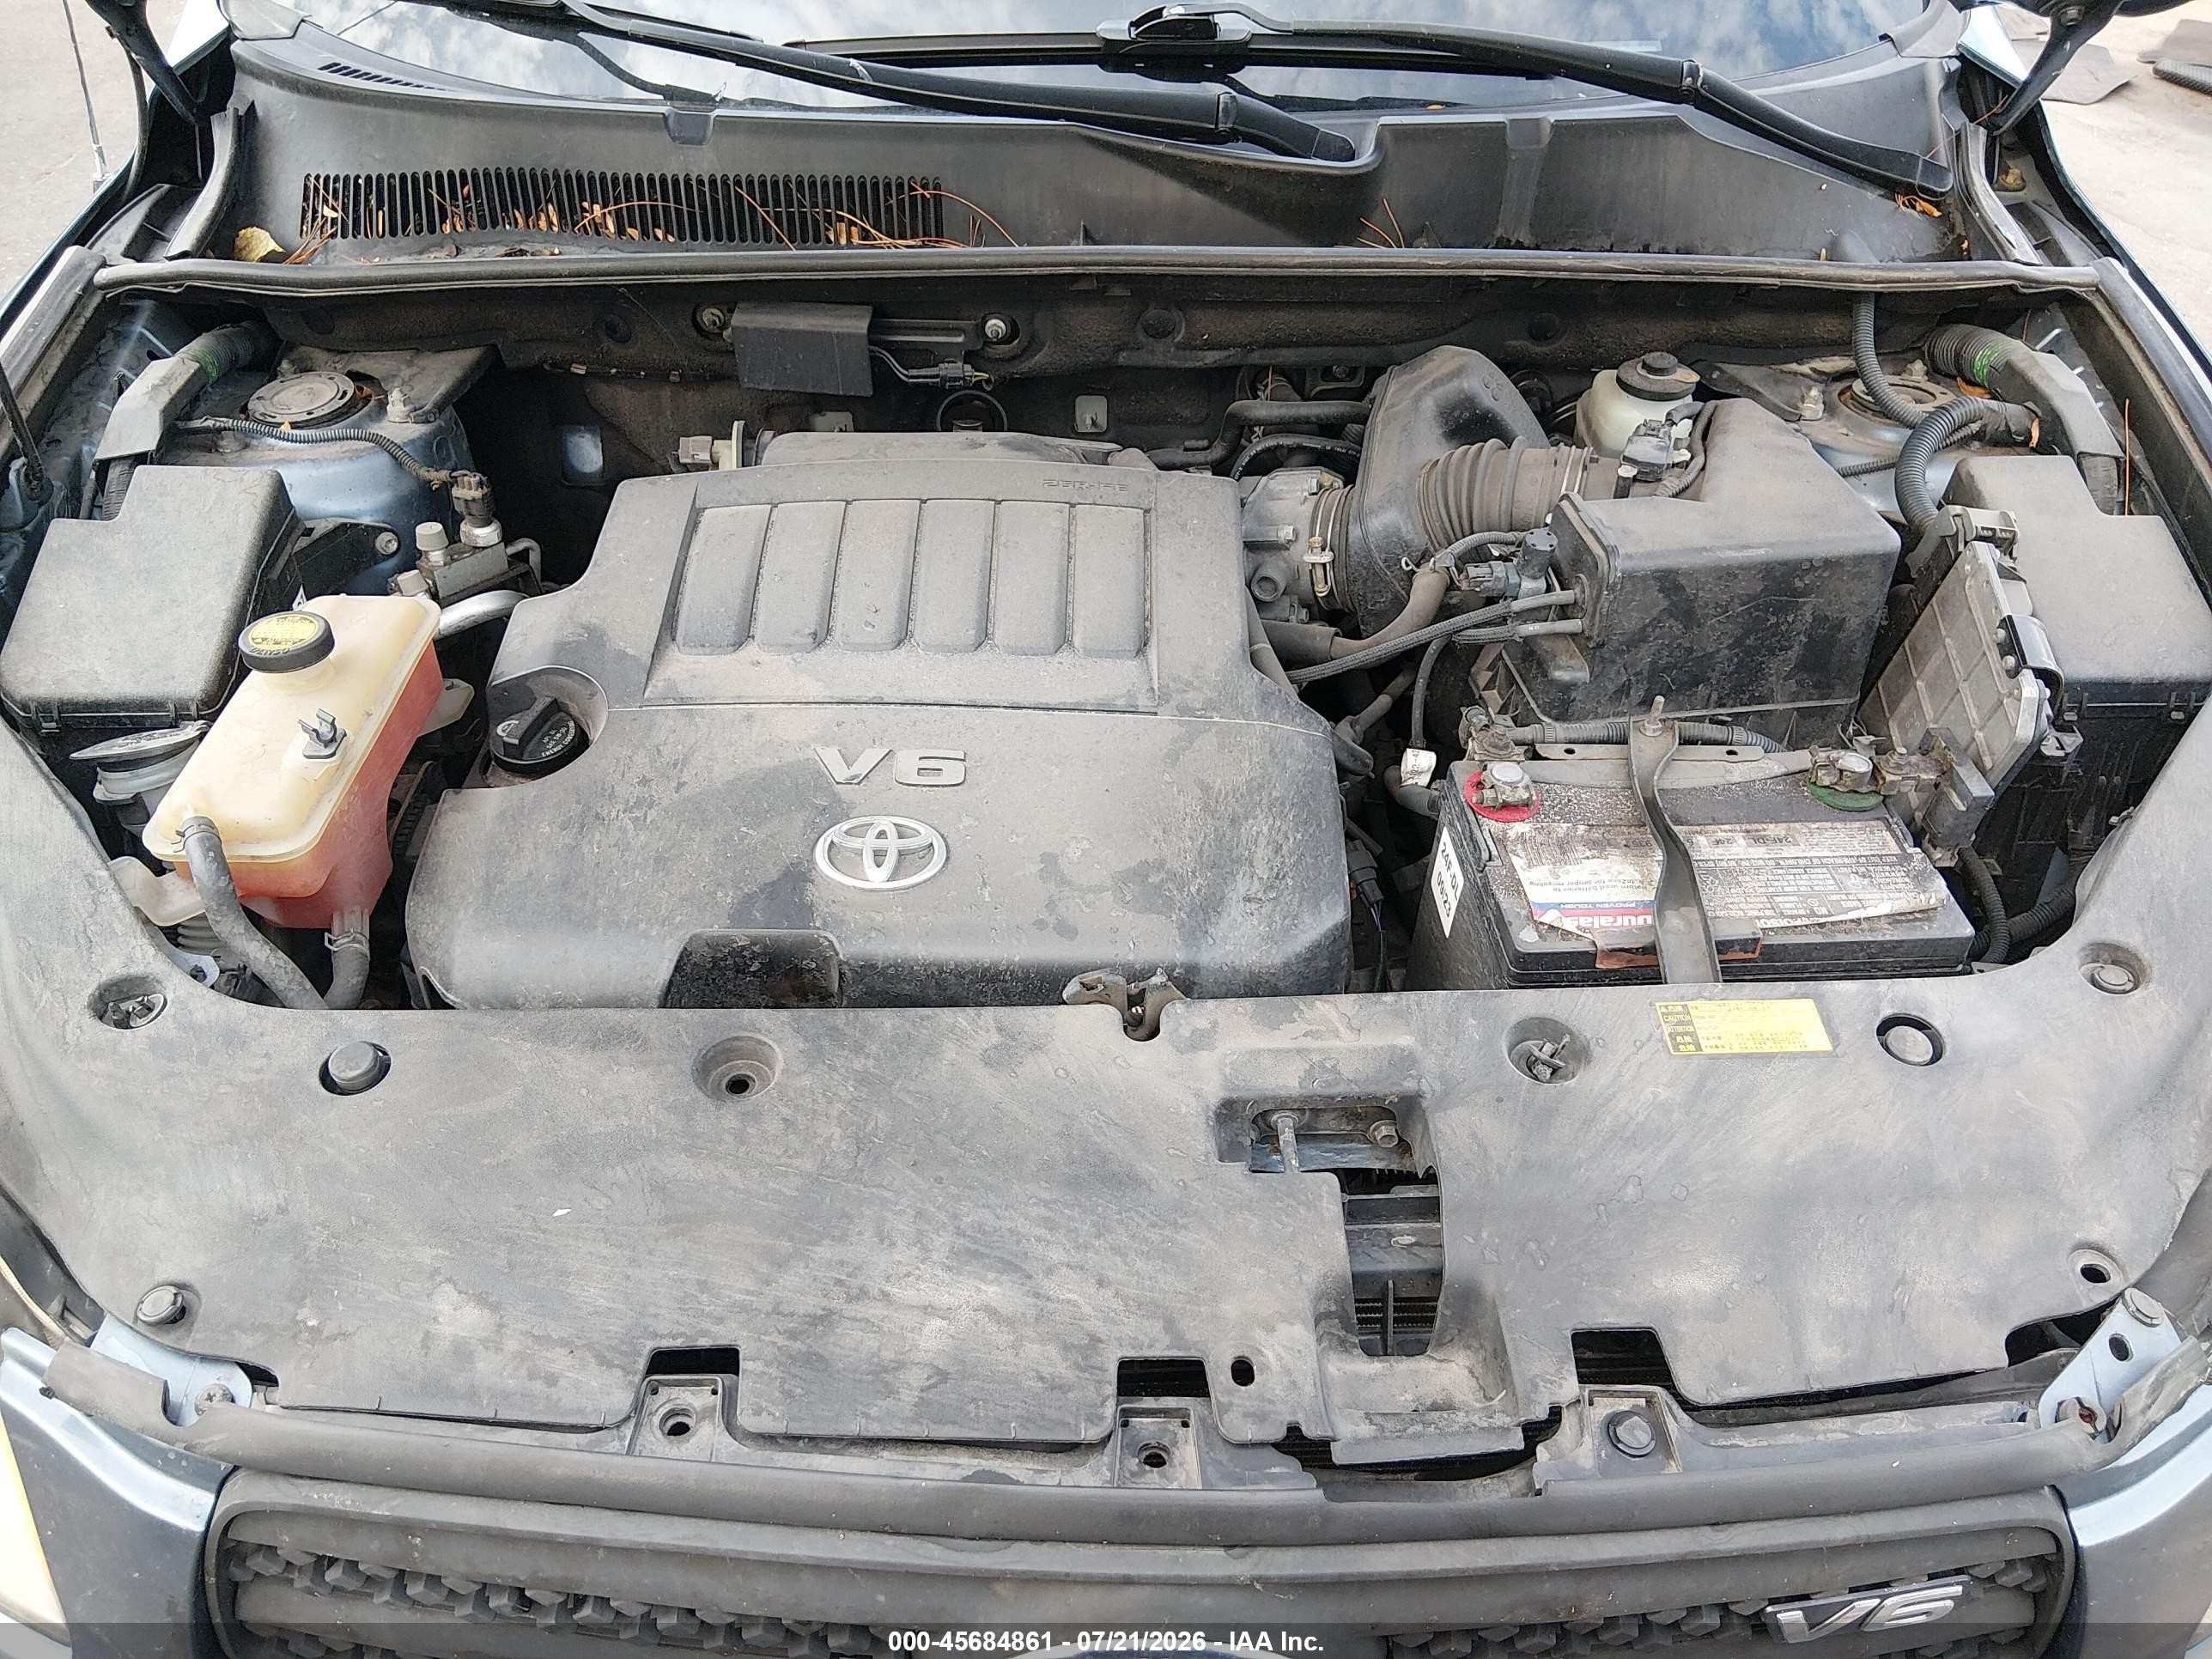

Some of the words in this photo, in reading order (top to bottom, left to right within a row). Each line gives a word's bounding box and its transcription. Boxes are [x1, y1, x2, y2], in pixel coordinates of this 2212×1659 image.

[541, 744, 565, 757] ENERGY
[814, 747, 966, 788] V6
[1441, 842, 1459, 901] 24F-DL
[1662, 1013, 1692, 1022] CAUTION
[1776, 1584, 1964, 1644] V6
